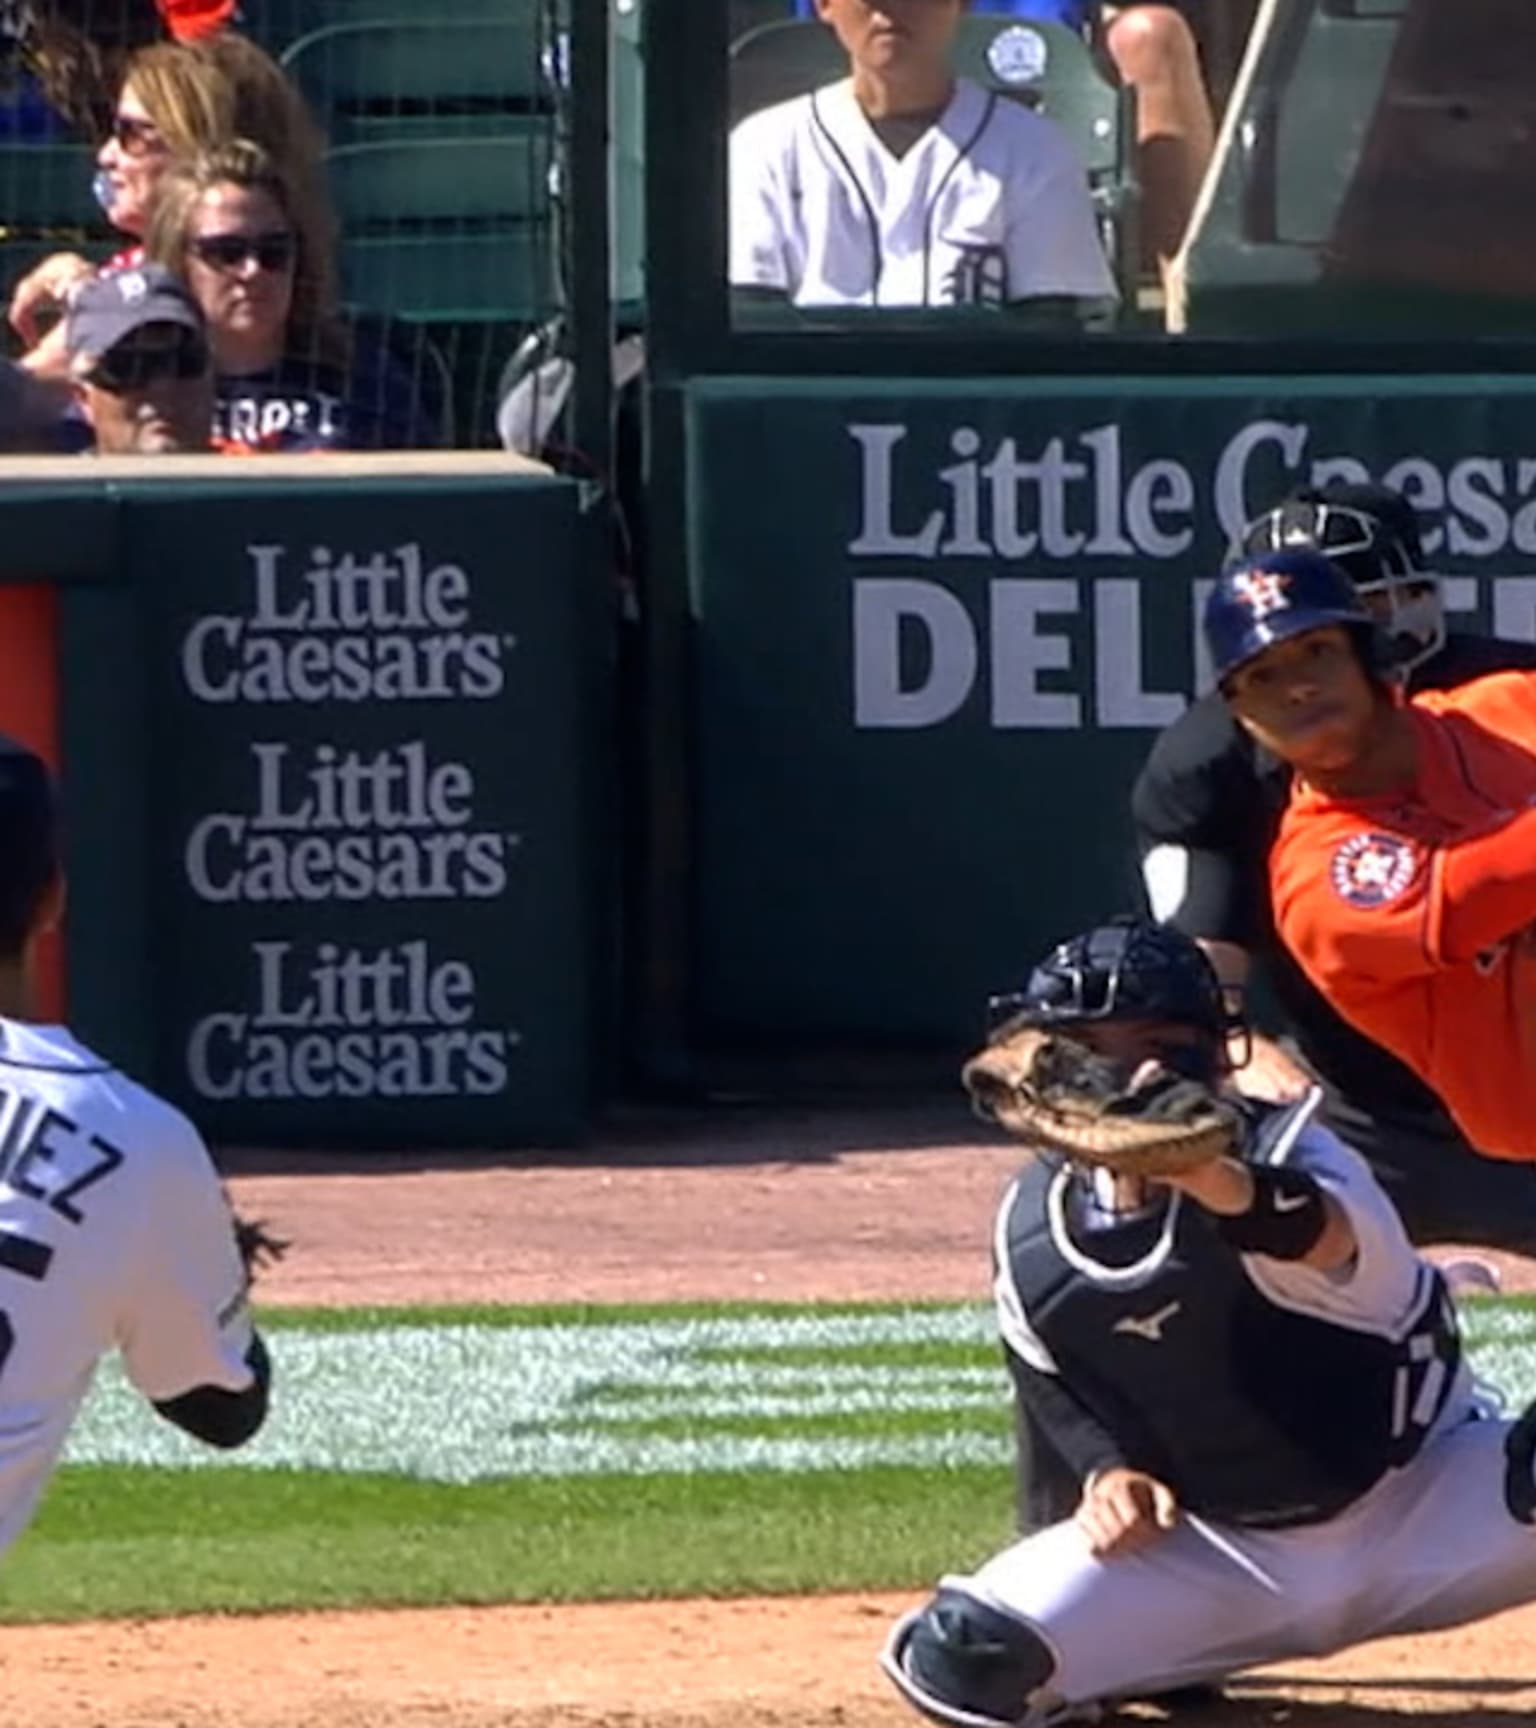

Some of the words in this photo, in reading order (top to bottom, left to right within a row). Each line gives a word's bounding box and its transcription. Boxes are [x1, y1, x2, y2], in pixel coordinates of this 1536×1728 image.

[855, 424, 1194, 558] Little
[247, 543, 469, 630] Little
[183, 615, 504, 701] Caesars
[251, 742, 473, 829] Little
[185, 813, 507, 901] Caesars
[252, 940, 475, 1028] Little
[187, 1012, 507, 1099] Caesars
